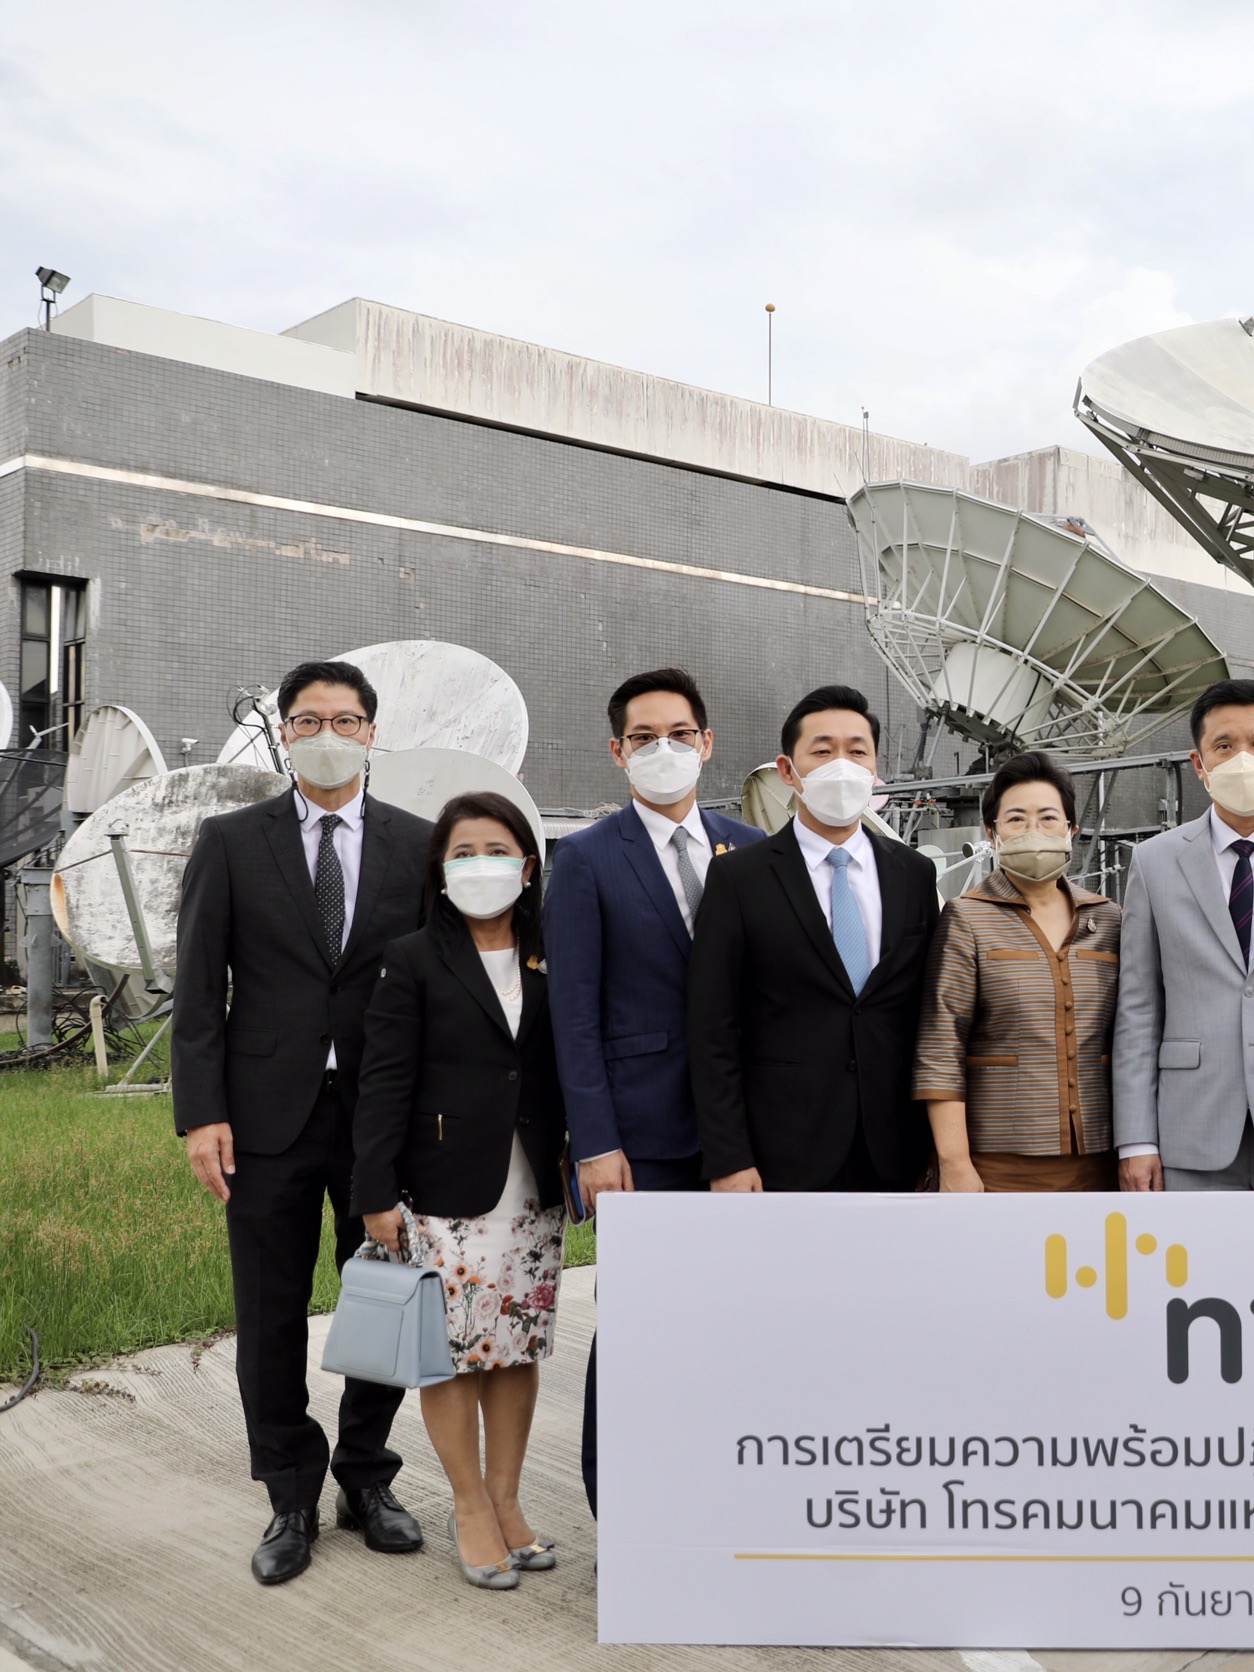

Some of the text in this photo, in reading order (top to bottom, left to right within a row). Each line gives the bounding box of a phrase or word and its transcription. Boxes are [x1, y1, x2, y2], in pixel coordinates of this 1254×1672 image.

[806, 1487, 927, 1530] บริษัท
[1121, 1586, 1143, 1617] 9
